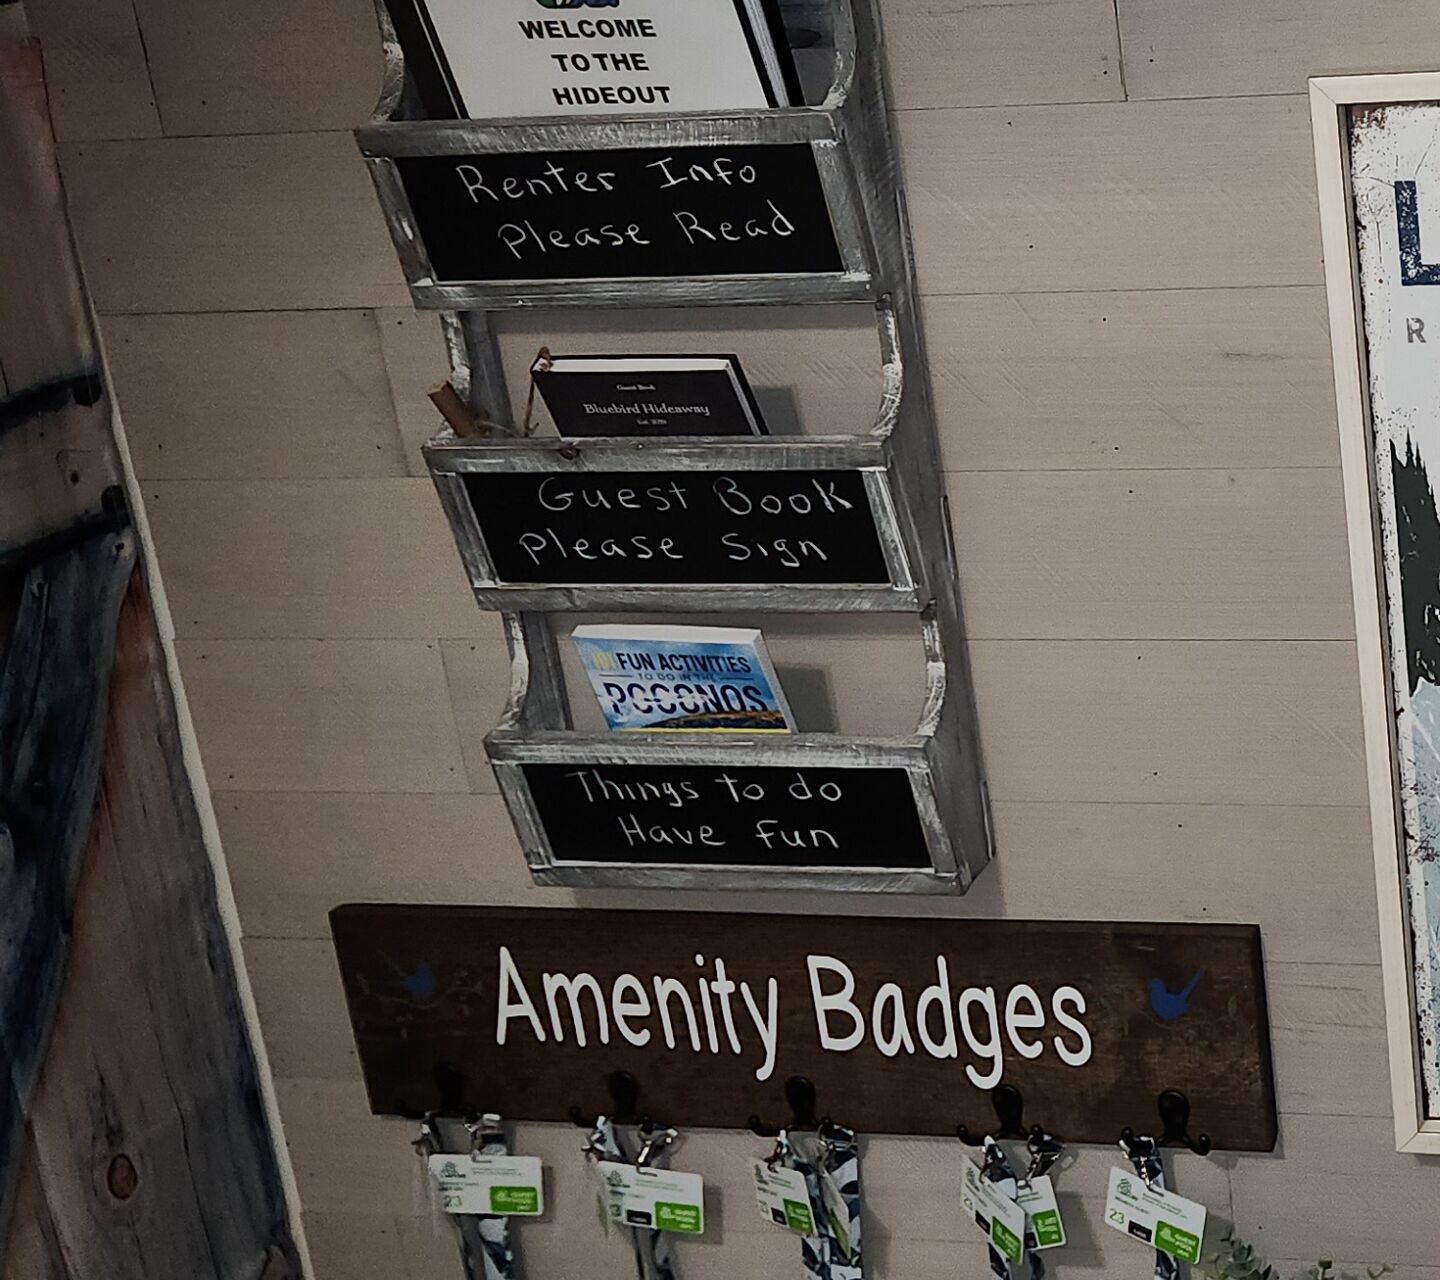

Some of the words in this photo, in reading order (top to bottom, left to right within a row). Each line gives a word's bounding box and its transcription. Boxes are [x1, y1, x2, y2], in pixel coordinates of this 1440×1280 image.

[517, 18, 657, 40] WELCOME
[551, 53, 590, 72] TO
[592, 52, 650, 71] THE
[552, 86, 670, 106] HIDEOUT
[455, 160, 616, 203] Renter
[645, 157, 757, 189] Info
[497, 219, 651, 260] Please
[672, 199, 795, 245] Read
[583, 402, 640, 415] Bluebird
[643, 402, 711, 417] Hideaway
[538, 476, 688, 512] Guest
[721, 532, 828, 568] Sign
[615, 652, 655, 671] FUN
[658, 653, 752, 674] ACTIVITIES
[603, 682, 768, 717] POCONOS
[564, 768, 700, 808] Things
[714, 773, 765, 803] to
[788, 772, 842, 802] do
[617, 813, 727, 847] Have
[495, 945, 779, 1083] Amenity
[806, 954, 1094, 1091] Badges
[1108, 1207, 1125, 1225] 23
